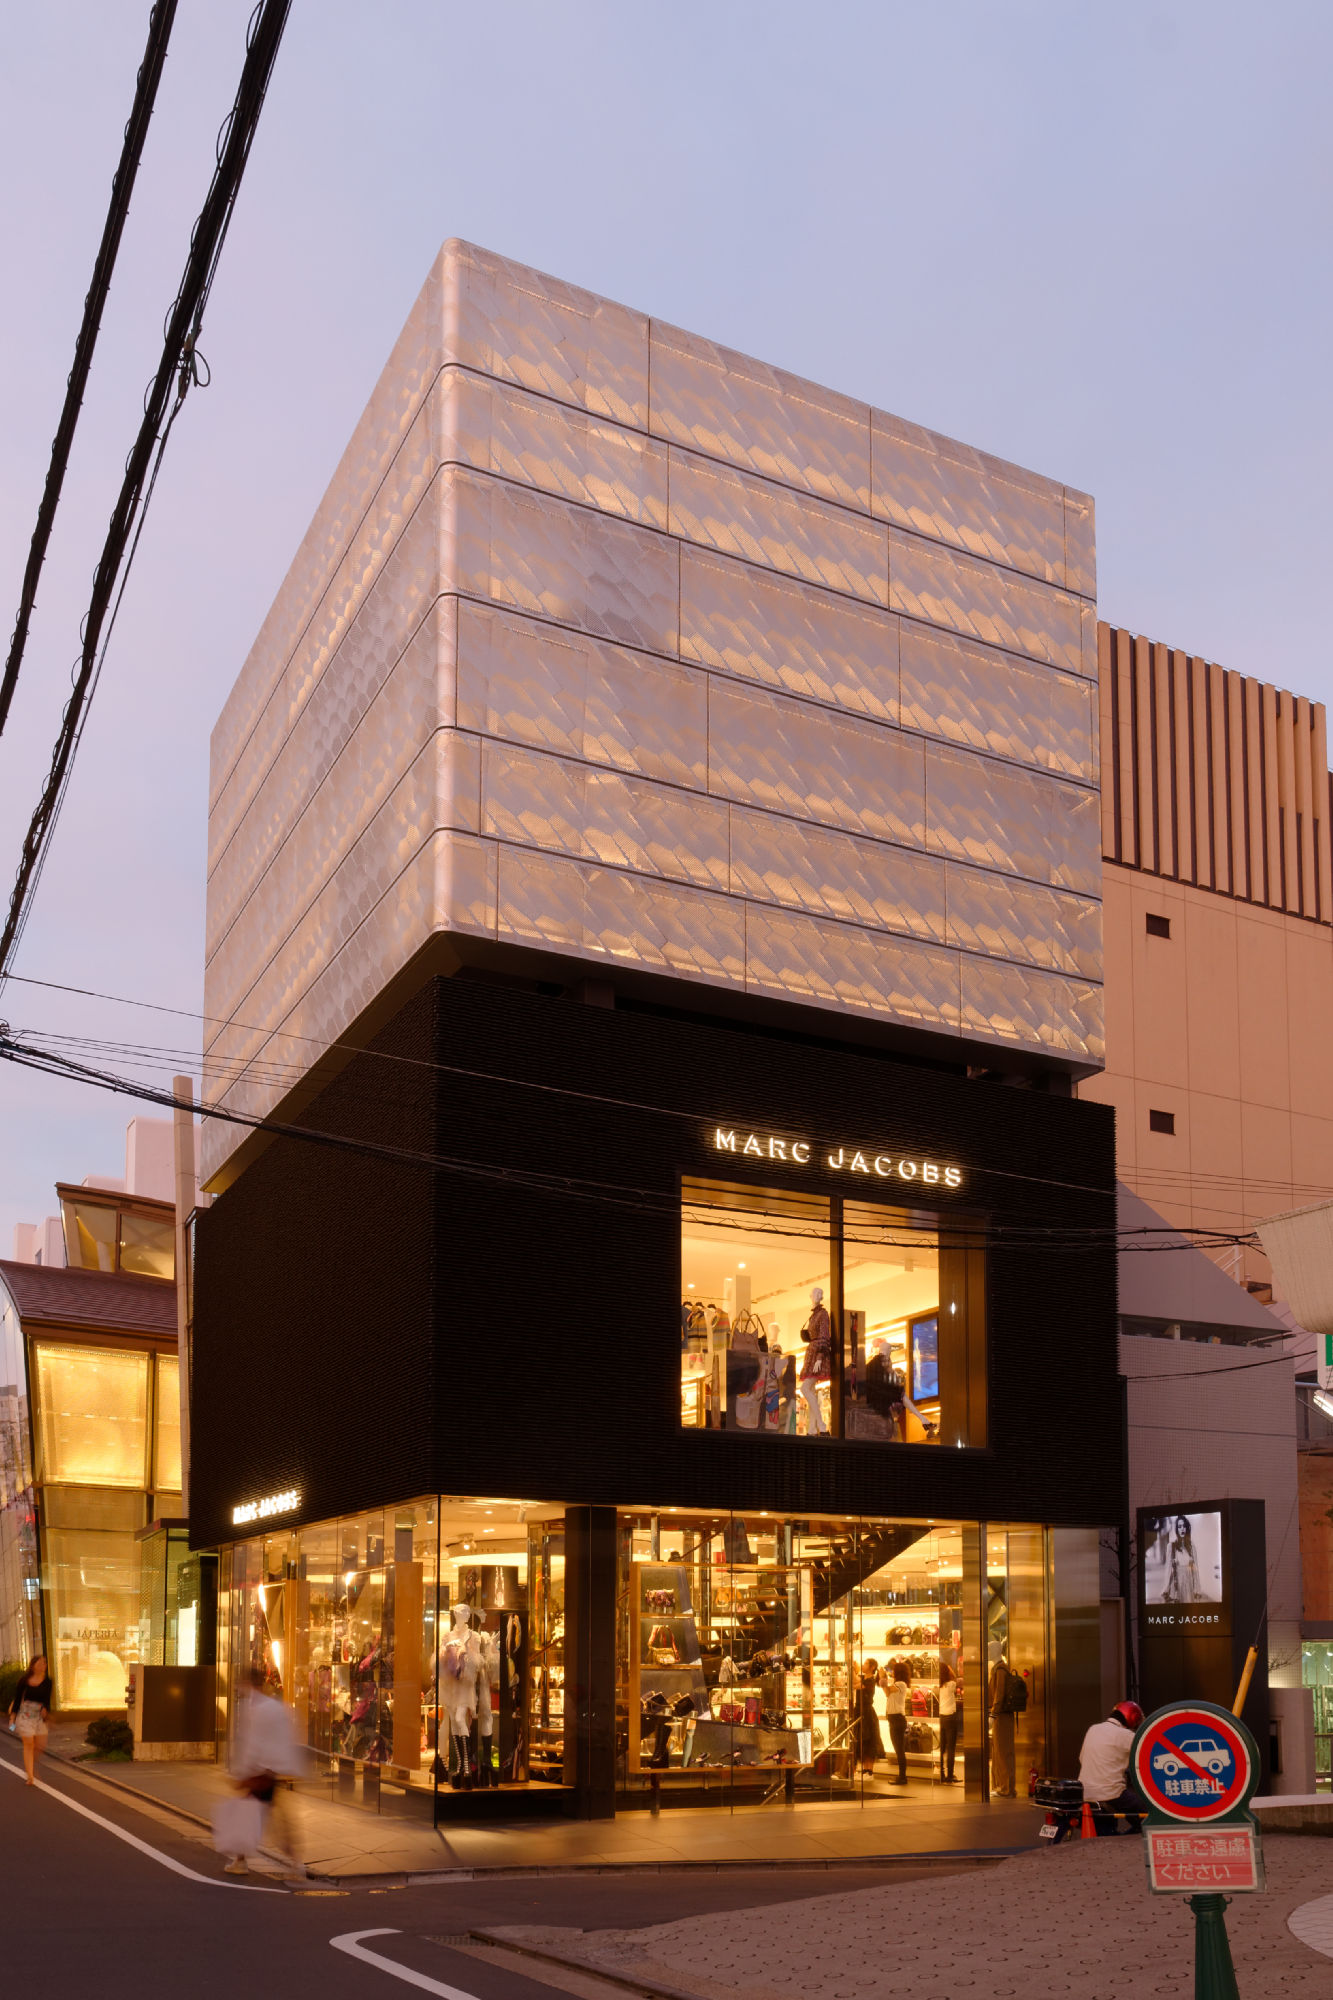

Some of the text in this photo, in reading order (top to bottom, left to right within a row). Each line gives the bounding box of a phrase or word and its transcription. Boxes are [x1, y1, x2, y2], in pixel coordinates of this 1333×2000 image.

[715, 1127, 963, 1187] MARC JACOBS
[1148, 1615, 1219, 1625] MARC JACOBS
[1164, 1777, 1226, 1797] 駐車禁止
[1156, 1837, 1246, 1858] 駐車ご遠慮
[1160, 1863, 1231, 1881] ください
